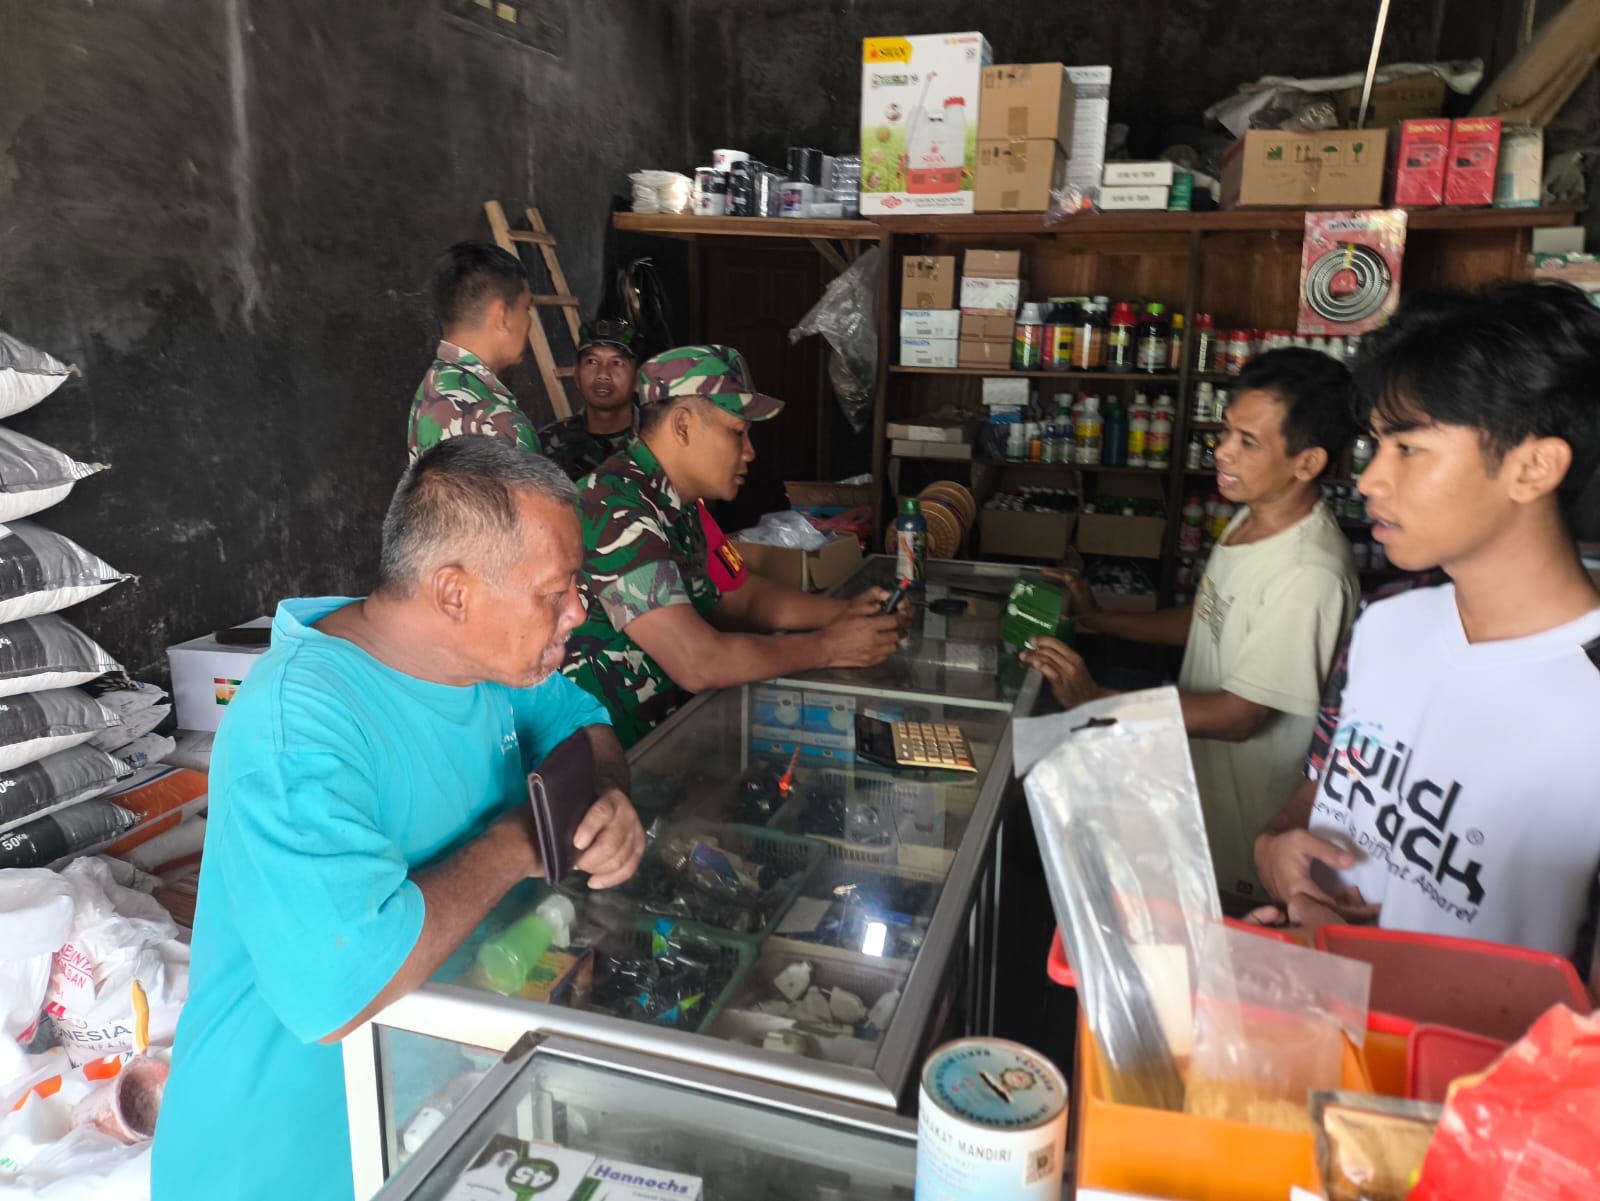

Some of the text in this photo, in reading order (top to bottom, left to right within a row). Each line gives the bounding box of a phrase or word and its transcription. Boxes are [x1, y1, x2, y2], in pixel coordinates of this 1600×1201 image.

[1346, 727, 1462, 833] wild
[1412, 875, 1477, 924] Apparel
[60, 1024, 132, 1043] NESIA
[958, 1140, 1012, 1162] MANDIRI
[594, 1164, 688, 1194] Hannochs
